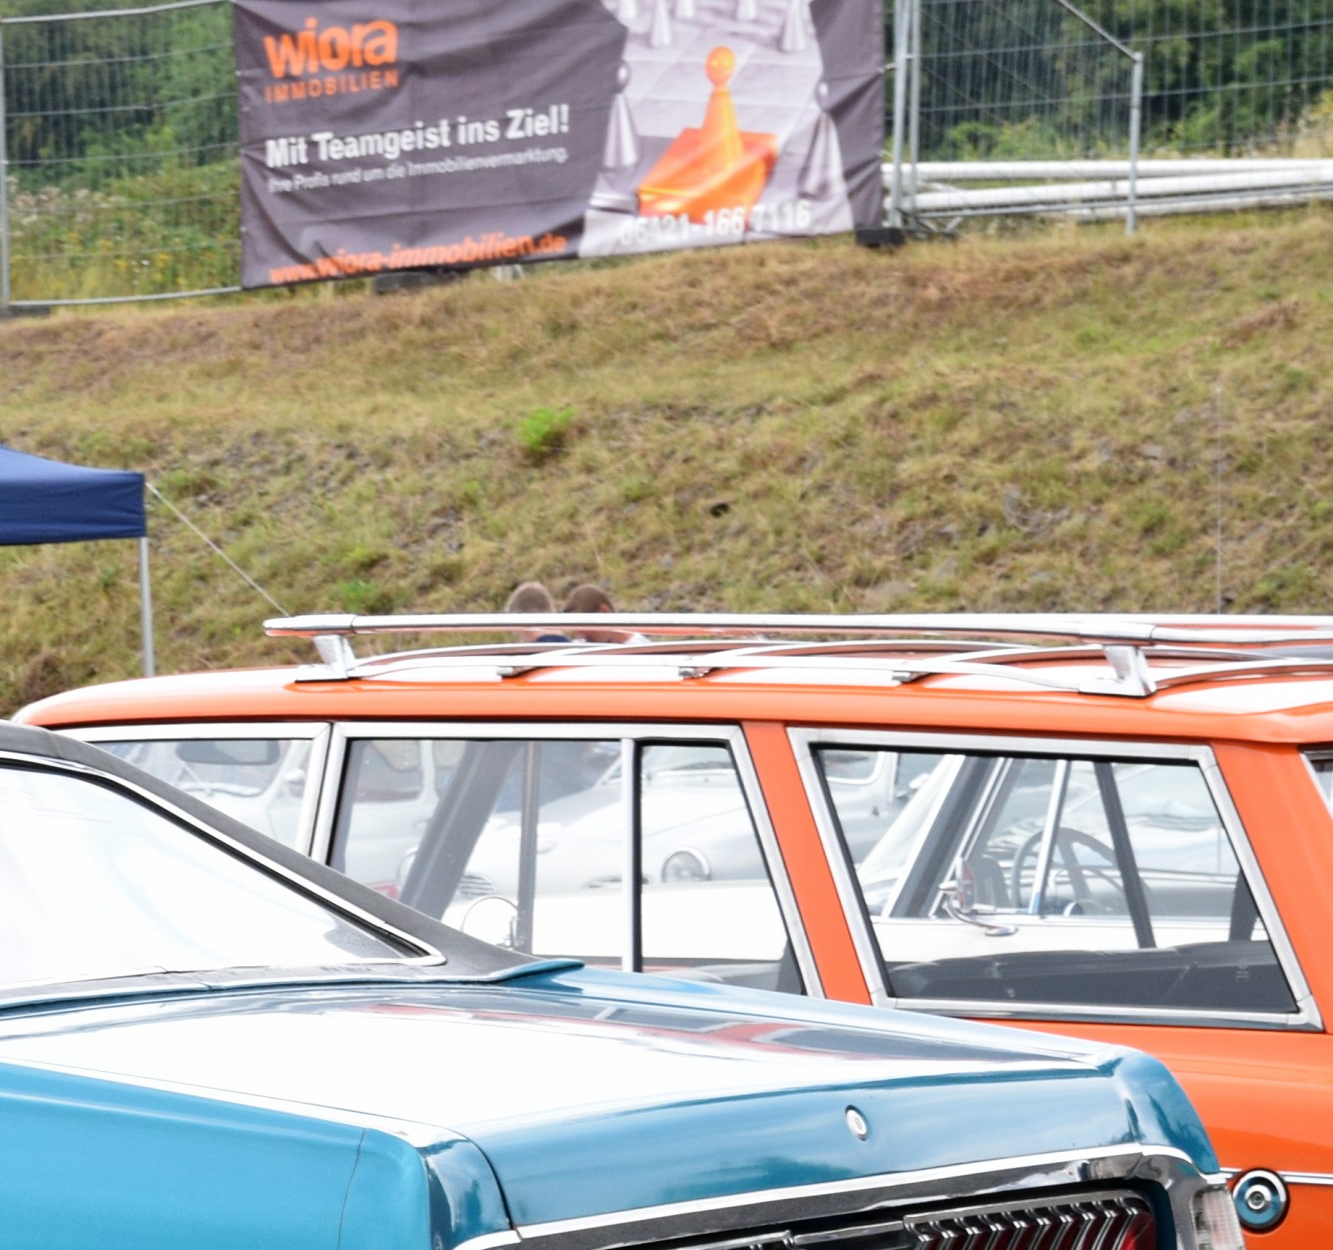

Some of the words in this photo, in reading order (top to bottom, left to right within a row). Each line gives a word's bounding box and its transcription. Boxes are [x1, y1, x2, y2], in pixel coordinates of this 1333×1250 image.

[263, 16, 399, 79] wiora
[264, 69, 400, 104] IMMOBILIEN
[265, 136, 309, 169] Mit
[310, 119, 451, 161] Teamgeist
[457, 115, 501, 146] ins
[505, 103, 570, 140] Ziel!
